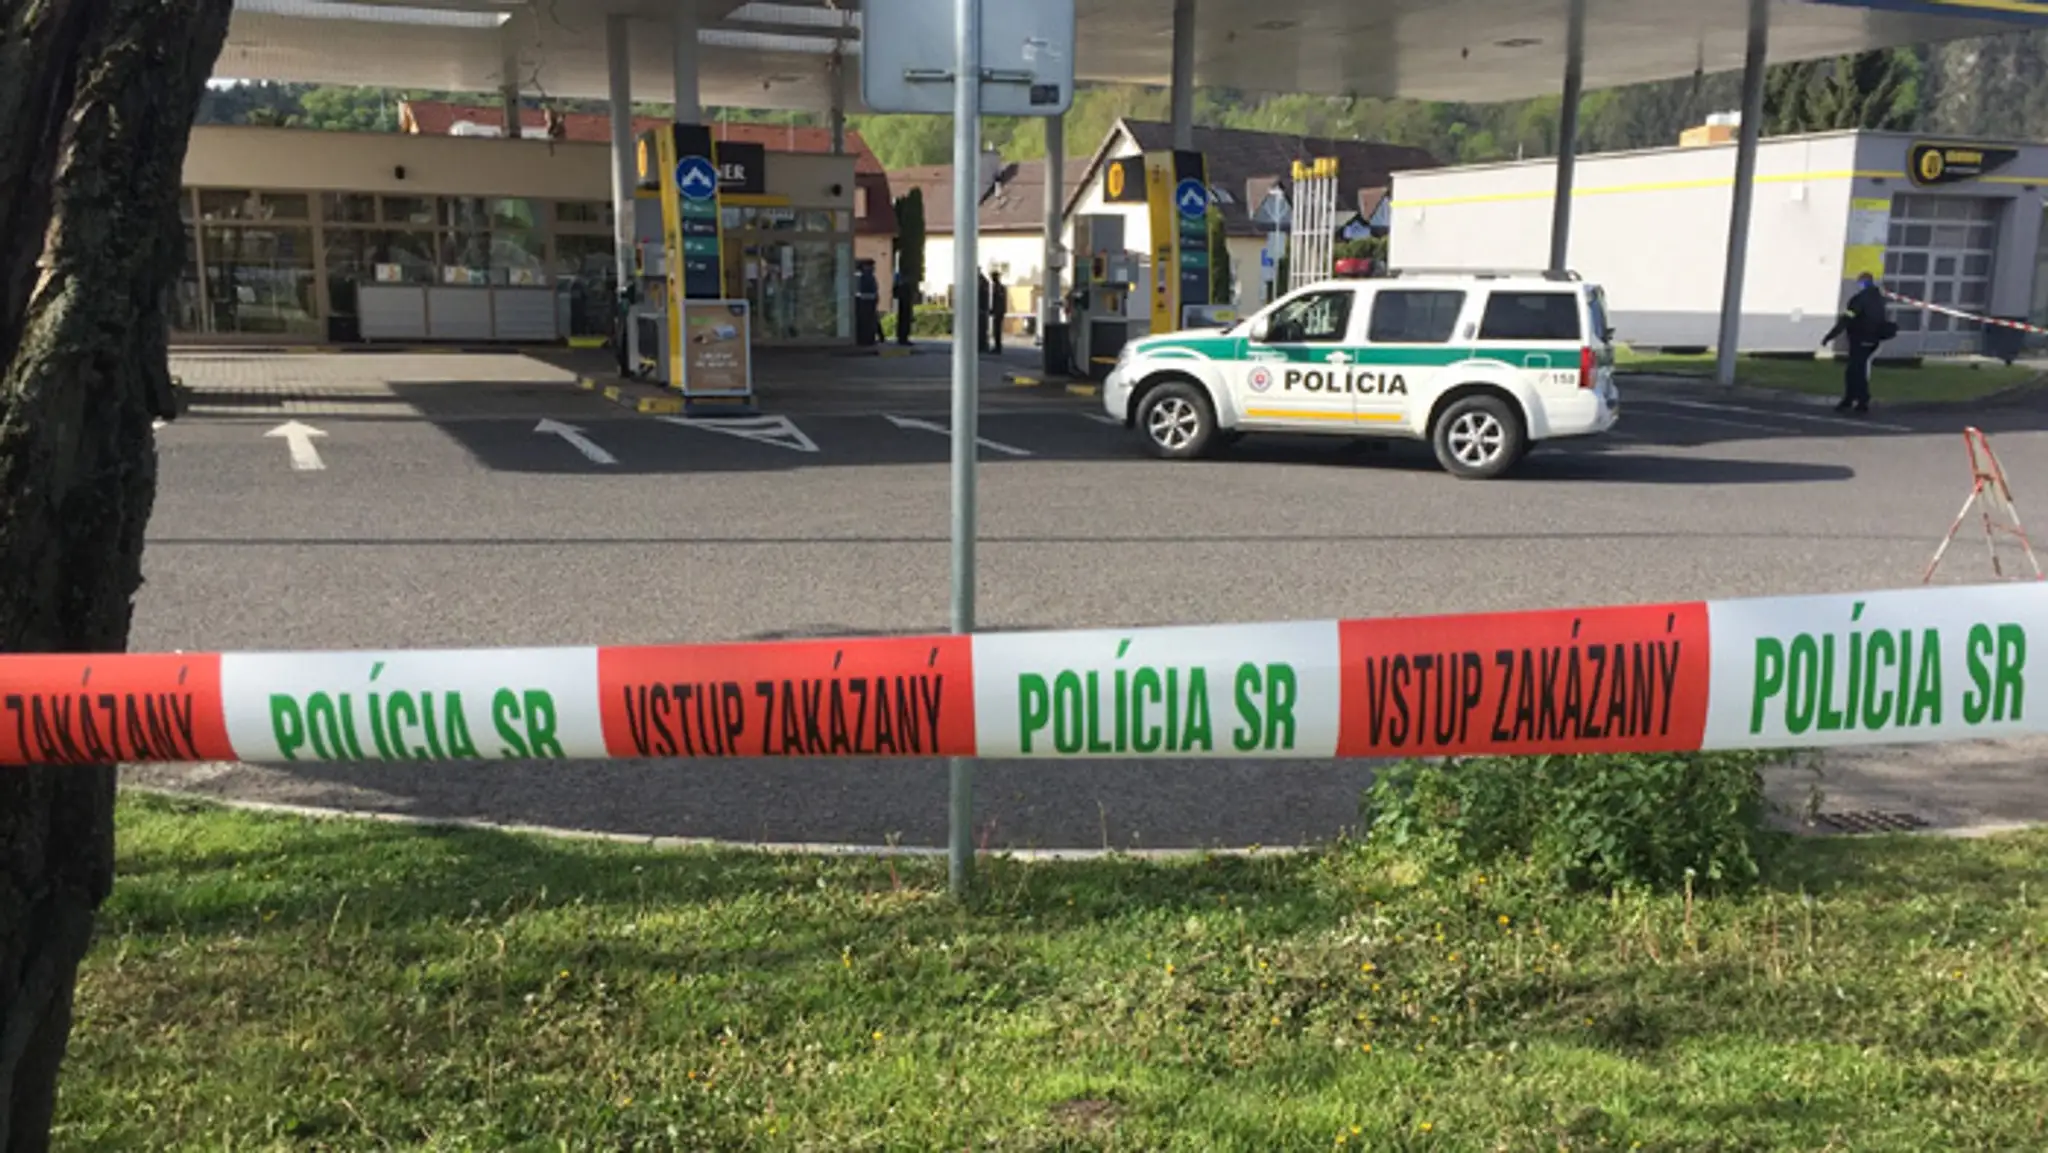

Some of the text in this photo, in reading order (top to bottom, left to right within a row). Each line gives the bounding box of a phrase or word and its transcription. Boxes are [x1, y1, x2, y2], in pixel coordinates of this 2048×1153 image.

[1285, 366, 1409, 395] POLÍCIA
[5, 602, 2028, 761] ZAKÁZANÝ POLÍCIA SR VSTUP ZAKÁZANÝ POLÍCIA SR VSTUP ZAKÁZANÝ POLÍCIA SR
